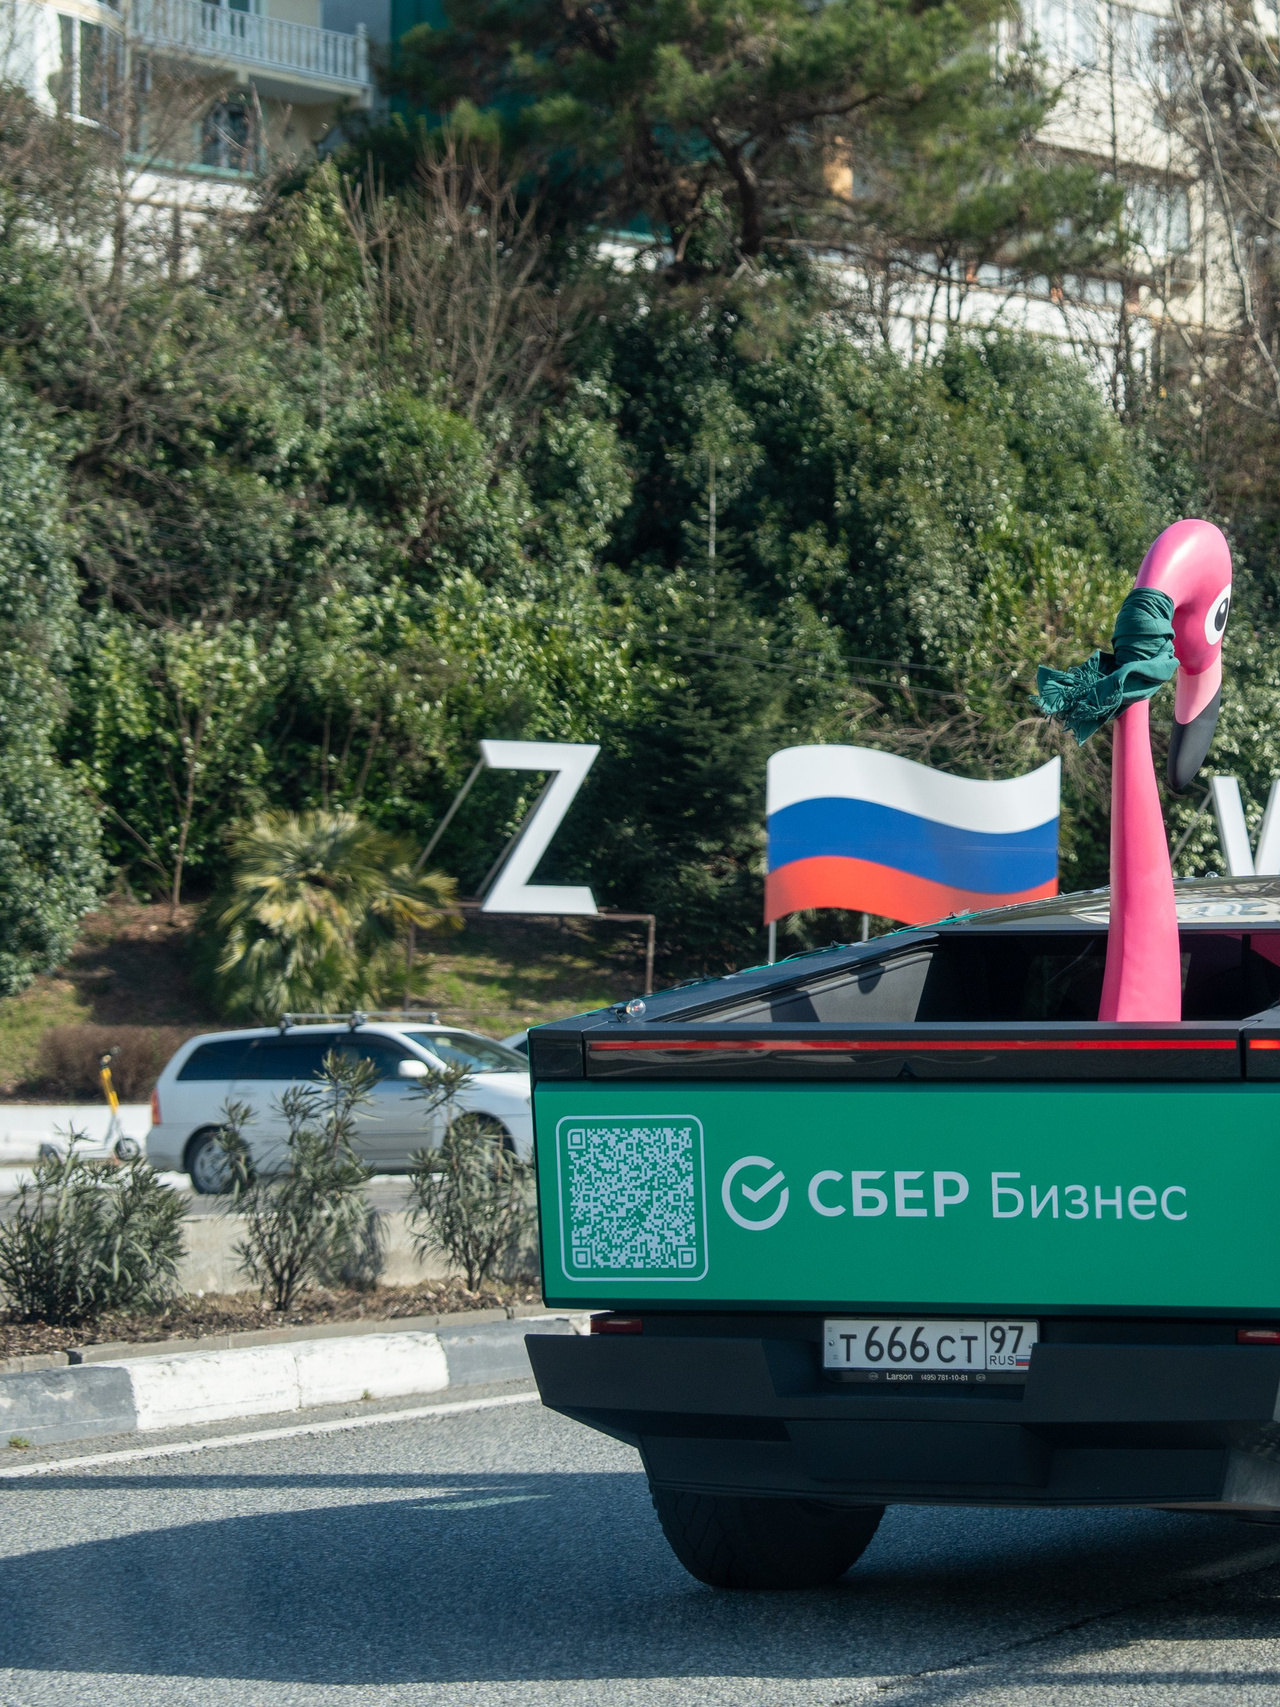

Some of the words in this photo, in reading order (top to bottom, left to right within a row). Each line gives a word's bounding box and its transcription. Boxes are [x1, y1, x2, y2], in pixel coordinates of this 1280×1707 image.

[479, 739, 600, 915] Z
[807, 1170, 970, 1218] СБЕР
[992, 1172, 1188, 1221] Бизнес
[990, 1325, 1024, 1354] 97
[990, 1355, 1015, 1366] RUS
[886, 1372, 914, 1381] Larson
